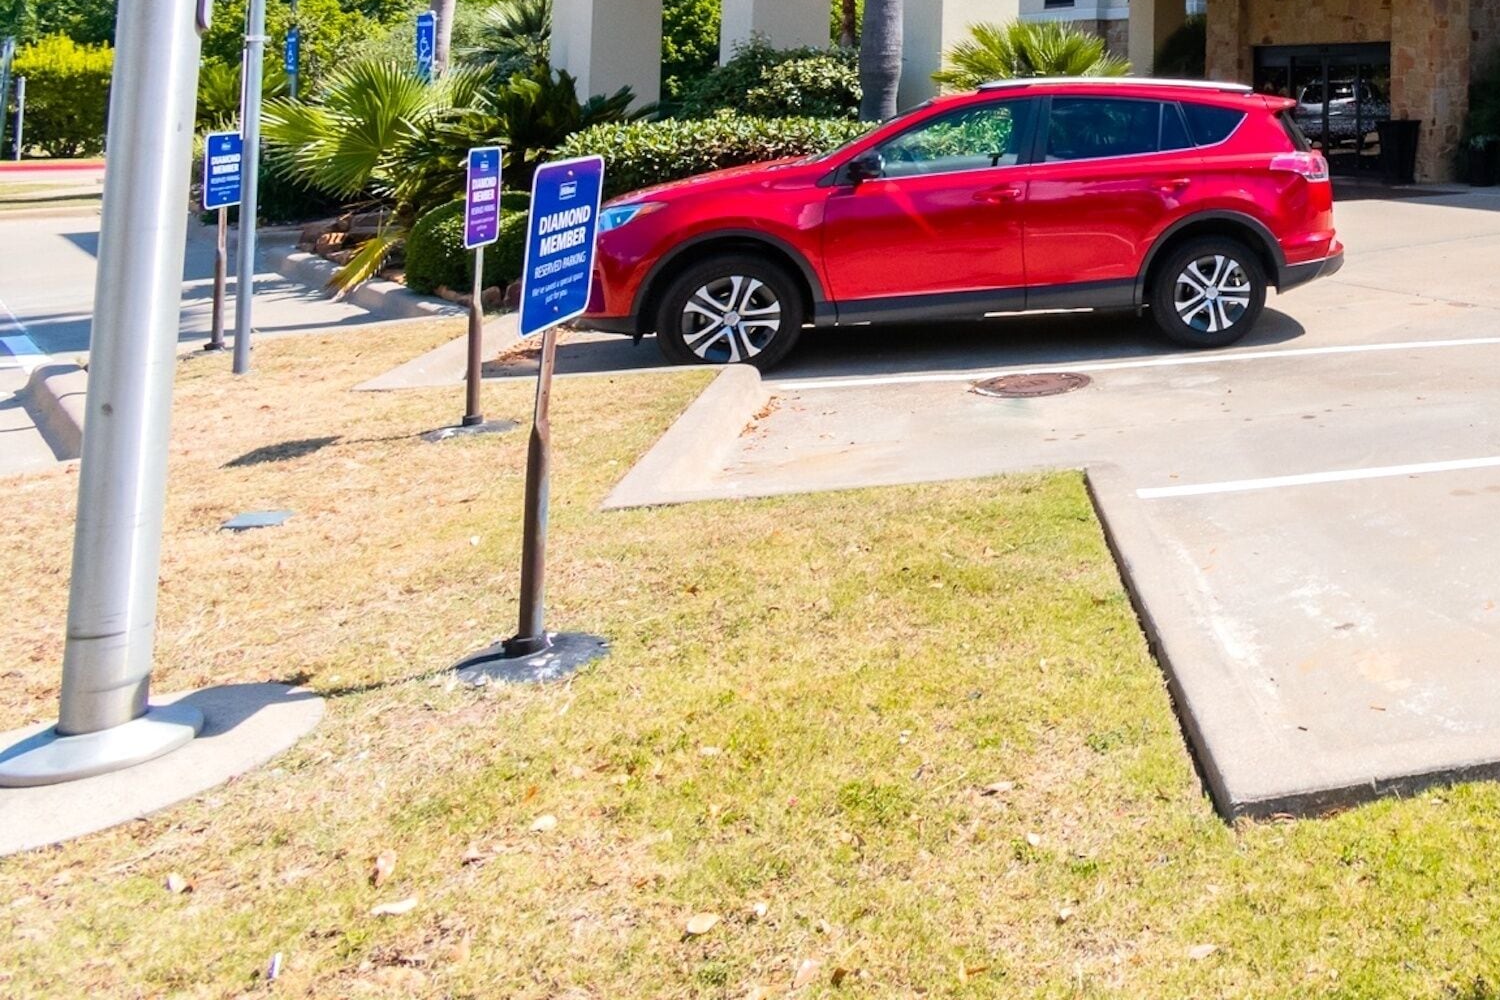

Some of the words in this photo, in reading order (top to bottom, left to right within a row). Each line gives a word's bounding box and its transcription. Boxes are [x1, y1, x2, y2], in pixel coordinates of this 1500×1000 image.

[211, 153, 241, 166] DIAMOND
[212, 163, 239, 175] MEMBER
[472, 176, 497, 190] DIAMOND
[472, 188, 495, 203] MEMBER
[539, 204, 591, 236] DIAMOND
[539, 226, 586, 257] MEMBER
[534, 259, 561, 279] RESERVED
[561, 250, 586, 269] PARKING
